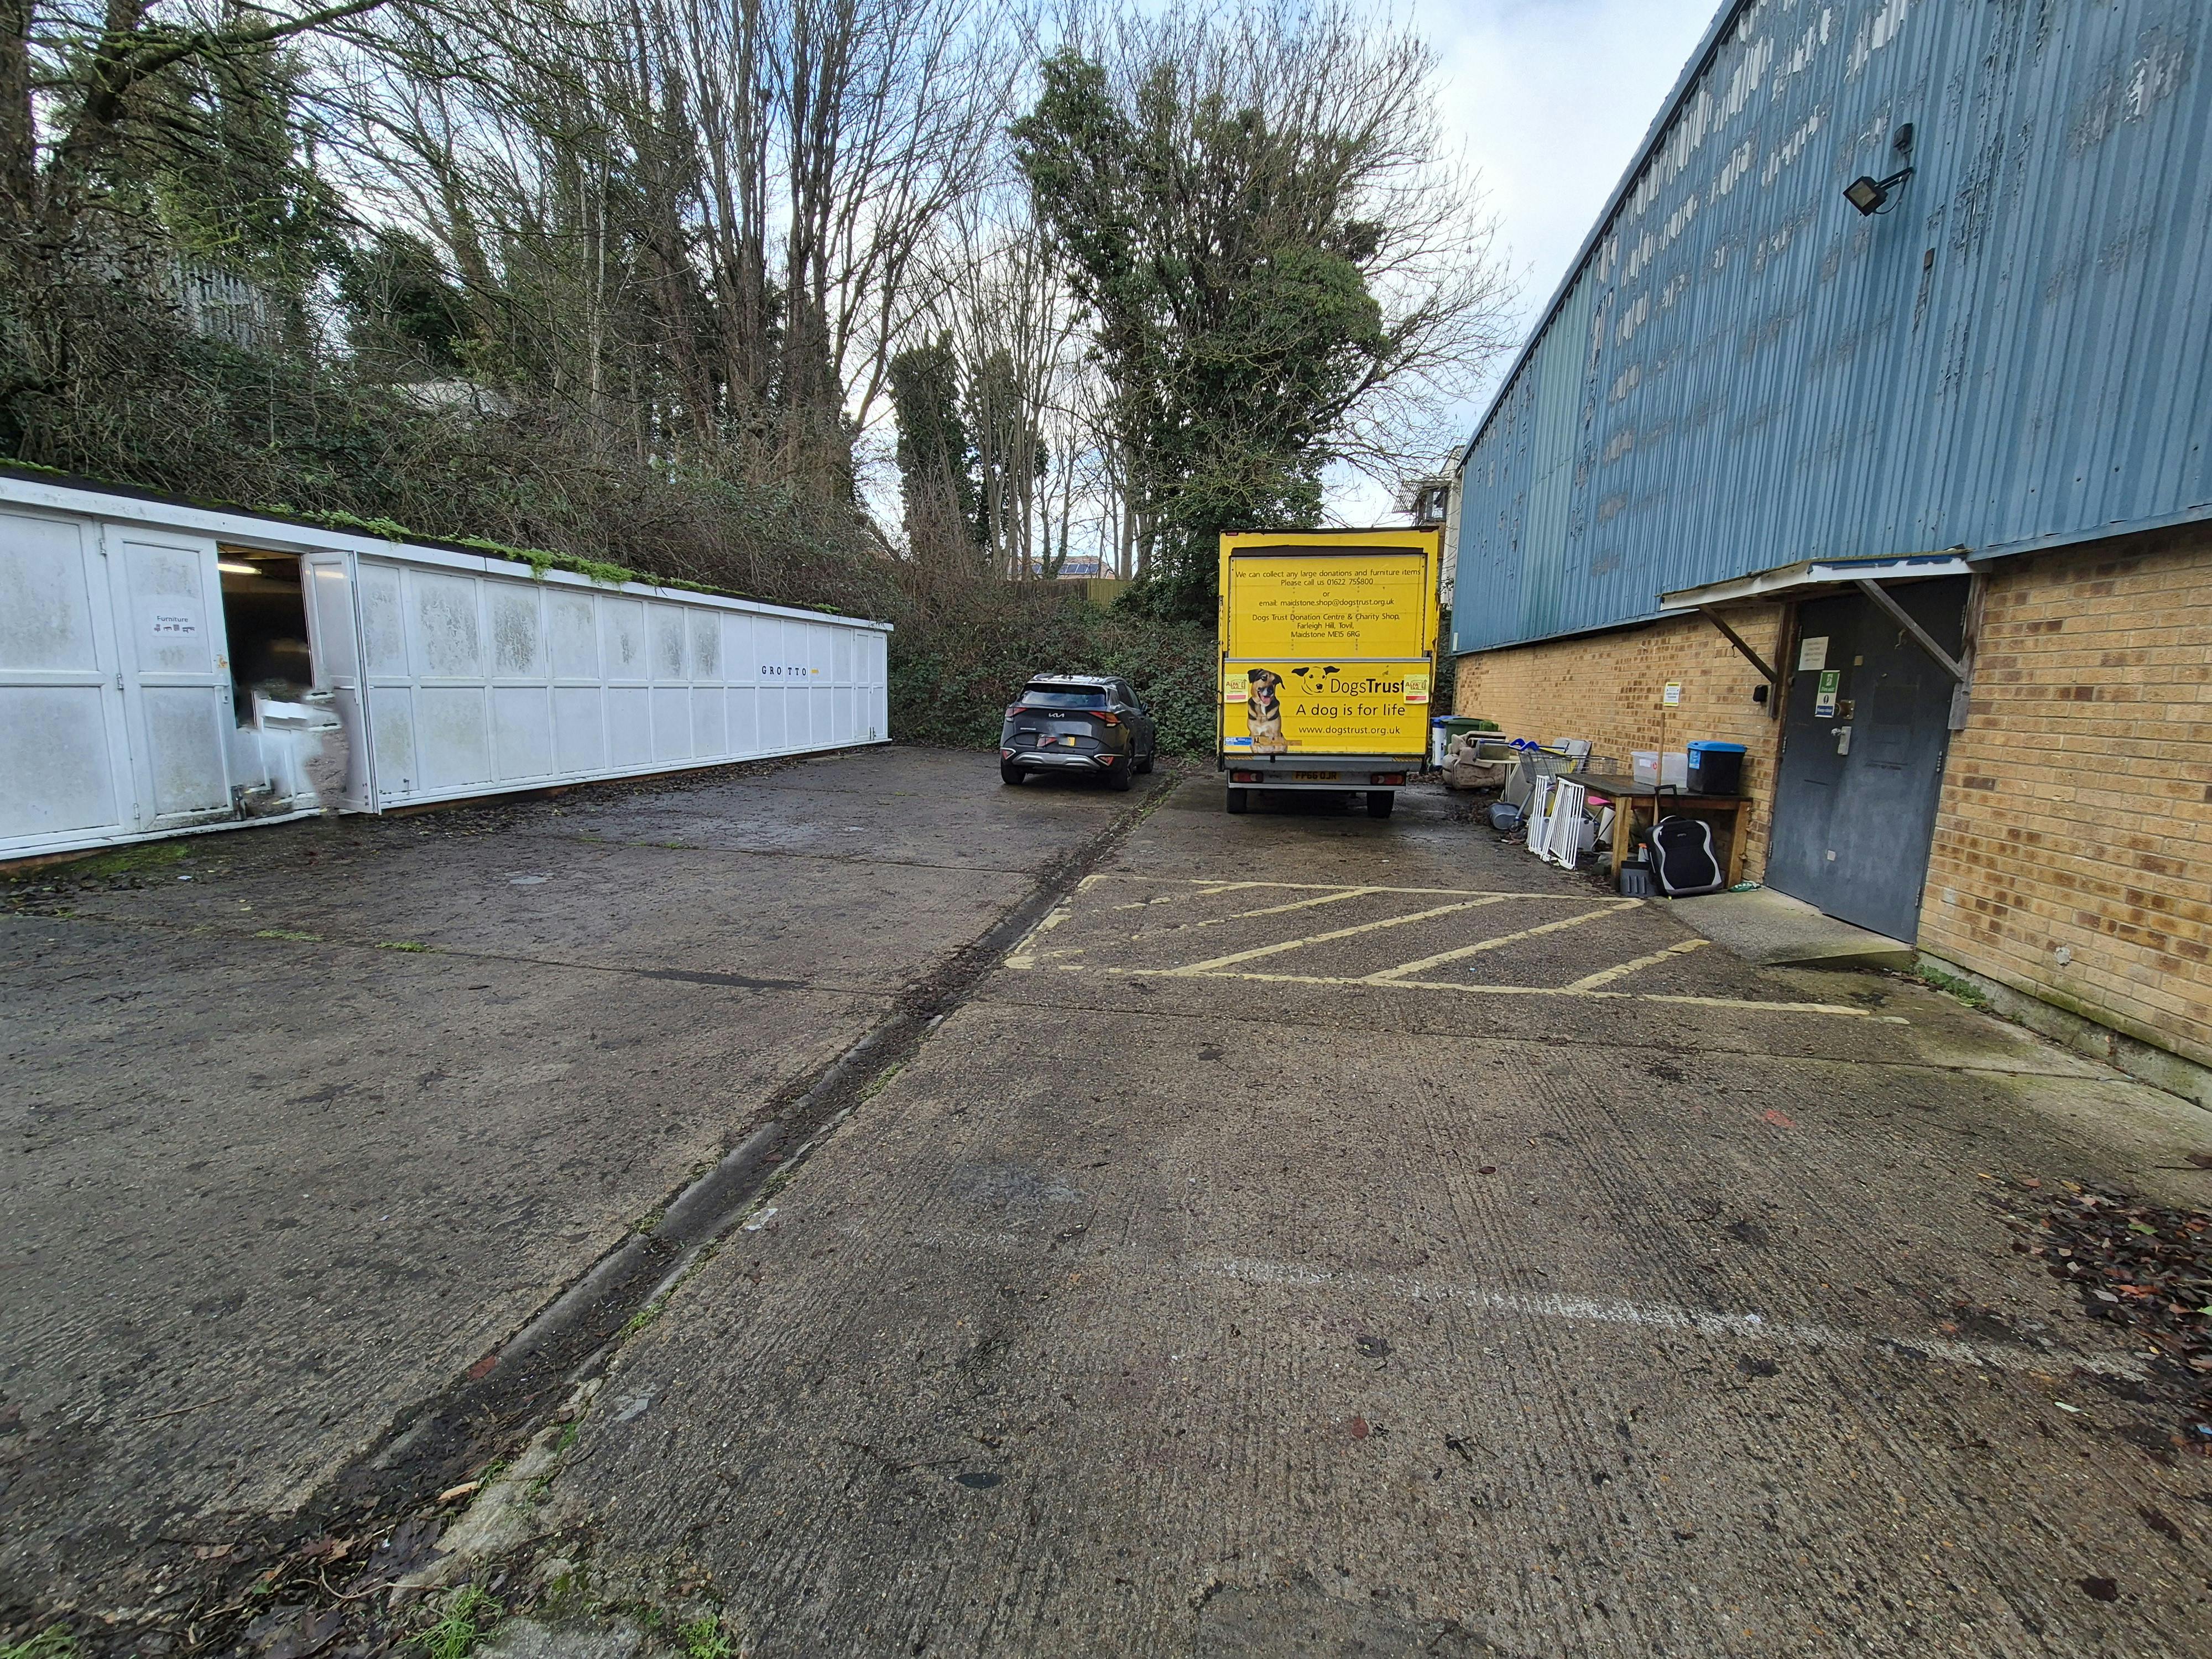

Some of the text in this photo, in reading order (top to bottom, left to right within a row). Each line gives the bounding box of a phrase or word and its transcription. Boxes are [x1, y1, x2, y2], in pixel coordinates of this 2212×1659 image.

[1280, 599, 1394, 607] maidstone.shop@dogstrust.org.uk
[1355, 613, 1379, 622] Charity
[1381, 613, 1400, 621] Shop,
[1297, 622, 1322, 630] Farleigh
[1296, 703, 1405, 718] A dog is for life
[1298, 726, 1400, 735] www.dogstrust.org.uk
